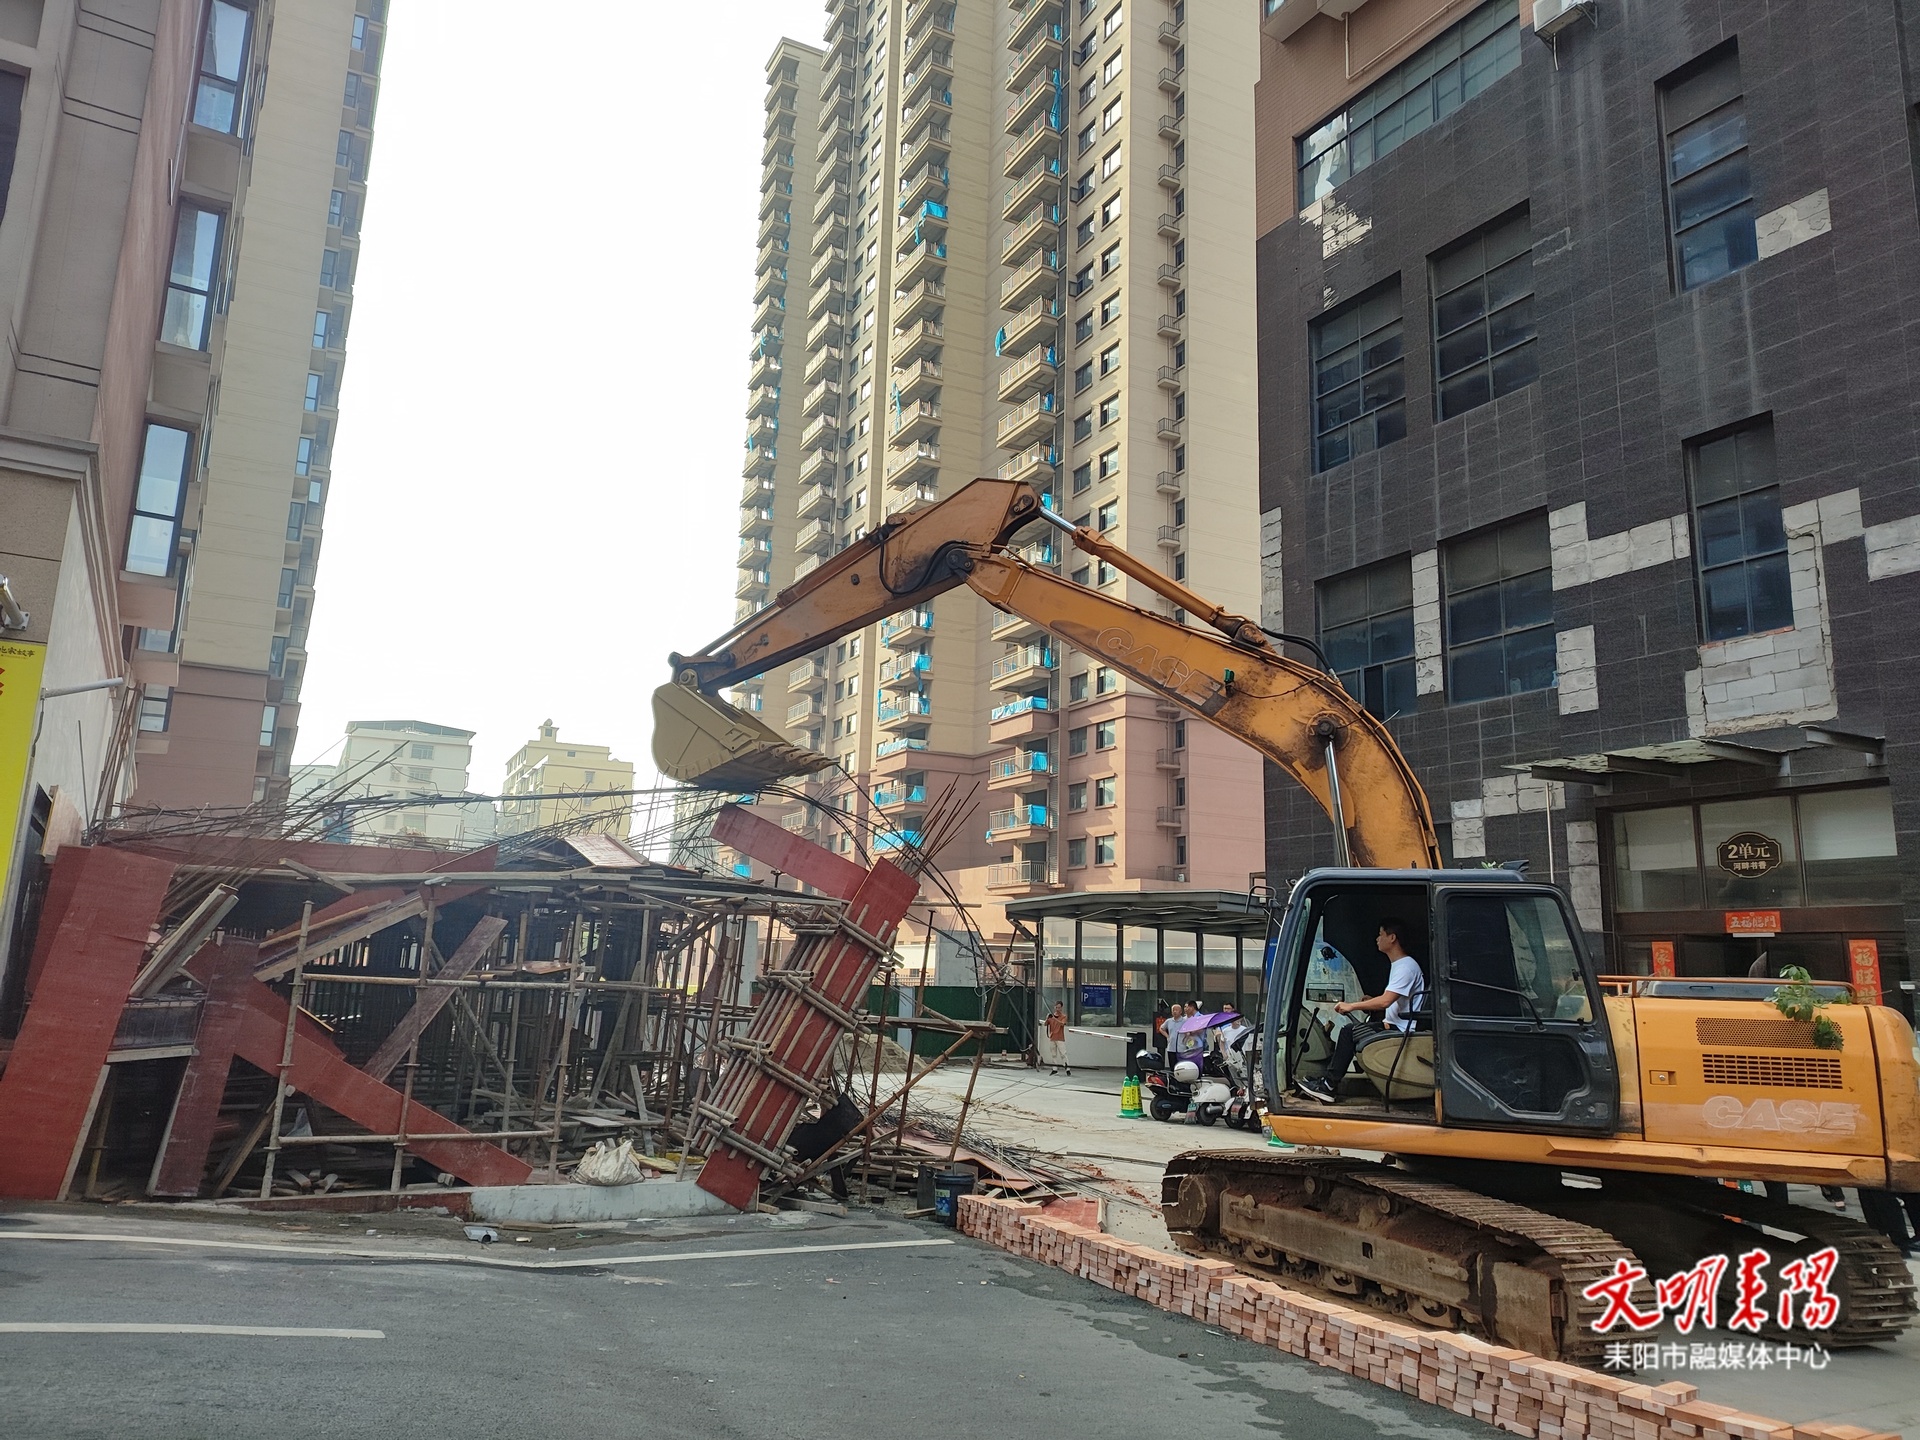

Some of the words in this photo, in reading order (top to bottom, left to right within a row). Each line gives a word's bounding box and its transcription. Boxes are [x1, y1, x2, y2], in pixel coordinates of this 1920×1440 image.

[1727, 842, 1771, 859] 2单元
[1733, 860, 1767, 870] 河畔书香
[1702, 1095, 1861, 1135] CASE
